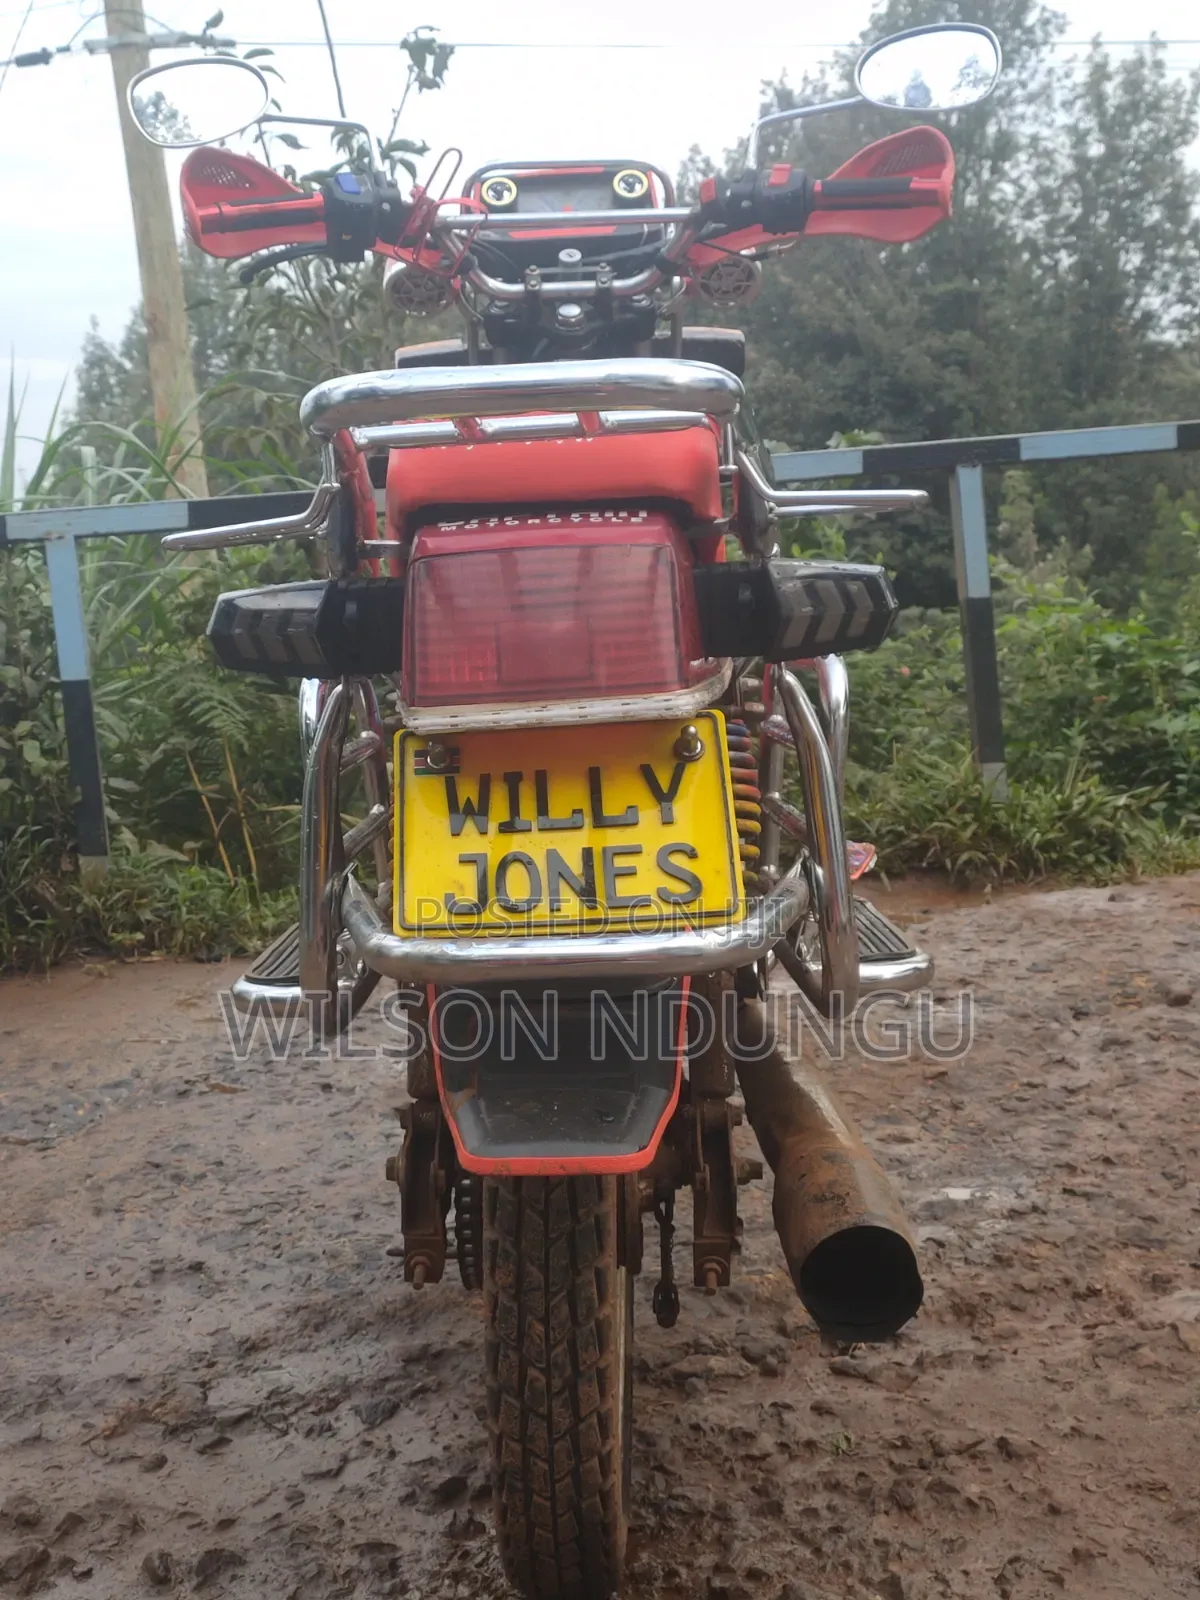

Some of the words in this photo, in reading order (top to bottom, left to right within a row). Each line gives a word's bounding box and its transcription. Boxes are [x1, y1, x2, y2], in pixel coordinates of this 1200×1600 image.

[440, 516, 643, 532] MOTORCYCLE
[444, 762, 688, 836] WILLY
[444, 842, 704, 915] JONES
